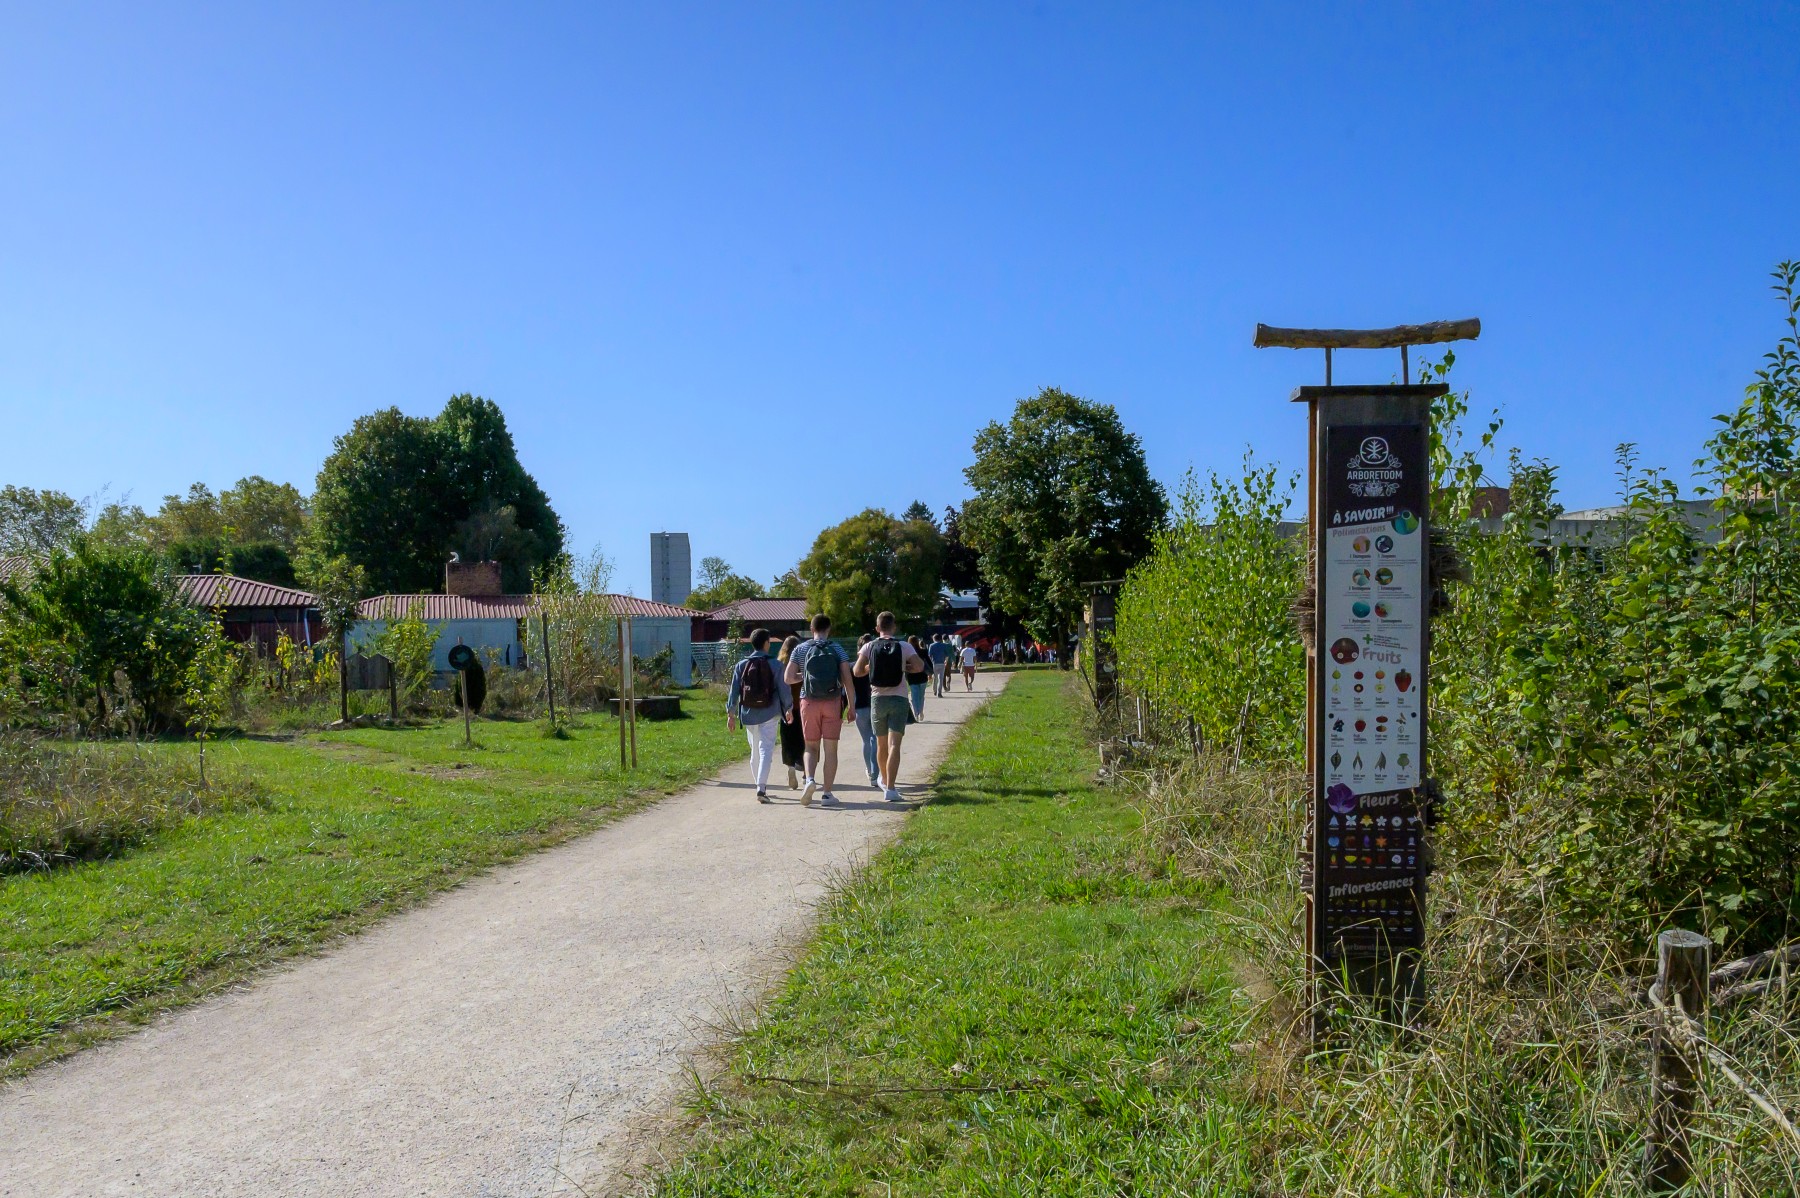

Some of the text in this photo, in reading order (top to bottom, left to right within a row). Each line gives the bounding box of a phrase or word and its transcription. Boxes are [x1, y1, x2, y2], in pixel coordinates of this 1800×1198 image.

[1347, 470, 1403, 480] ARBORETOOM
[1333, 510, 1342, 525] À
[1362, 647, 1402, 664] Fruits
[1359, 794, 1399, 809] Fleurs
[1328, 876, 1415, 898] Inflorescences
